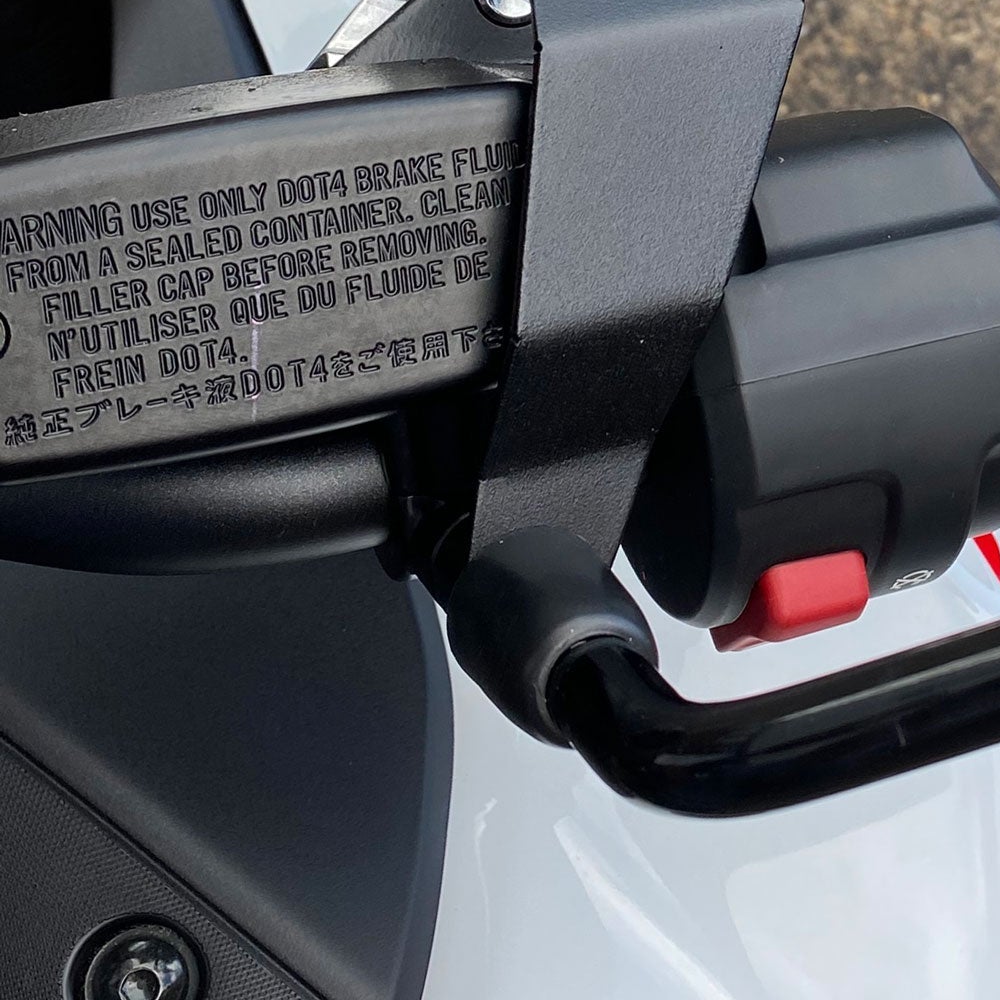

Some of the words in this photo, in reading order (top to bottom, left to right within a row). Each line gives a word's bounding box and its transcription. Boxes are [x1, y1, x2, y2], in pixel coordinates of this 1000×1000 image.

[0, 201, 124, 256] ARNING
[131, 195, 191, 232] USE
[199, 182, 268, 222] ONLY
[278, 170, 348, 209] DOT4
[354, 153, 445, 194] BRAKE
[6, 250, 90, 293] FROM
[99, 246, 119, 277] A
[125, 225, 243, 271] SEALED
[250, 196, 414, 247] CONTAINER.
[420, 177, 511, 218] CLEAN
[42, 279, 152, 325] FILLER
[157, 266, 214, 303] CAP
[223, 245, 335, 290] BEFORE
[340, 218, 487, 270] REMOVING.
[230, 291, 289, 326] QUE
[298, 281, 336, 311] DU
[345, 260, 446, 306] FLUIDE
[455, 251, 491, 282] DE
[52, 354, 146, 399] FREIN
[158, 336, 249, 379] DOT4.
